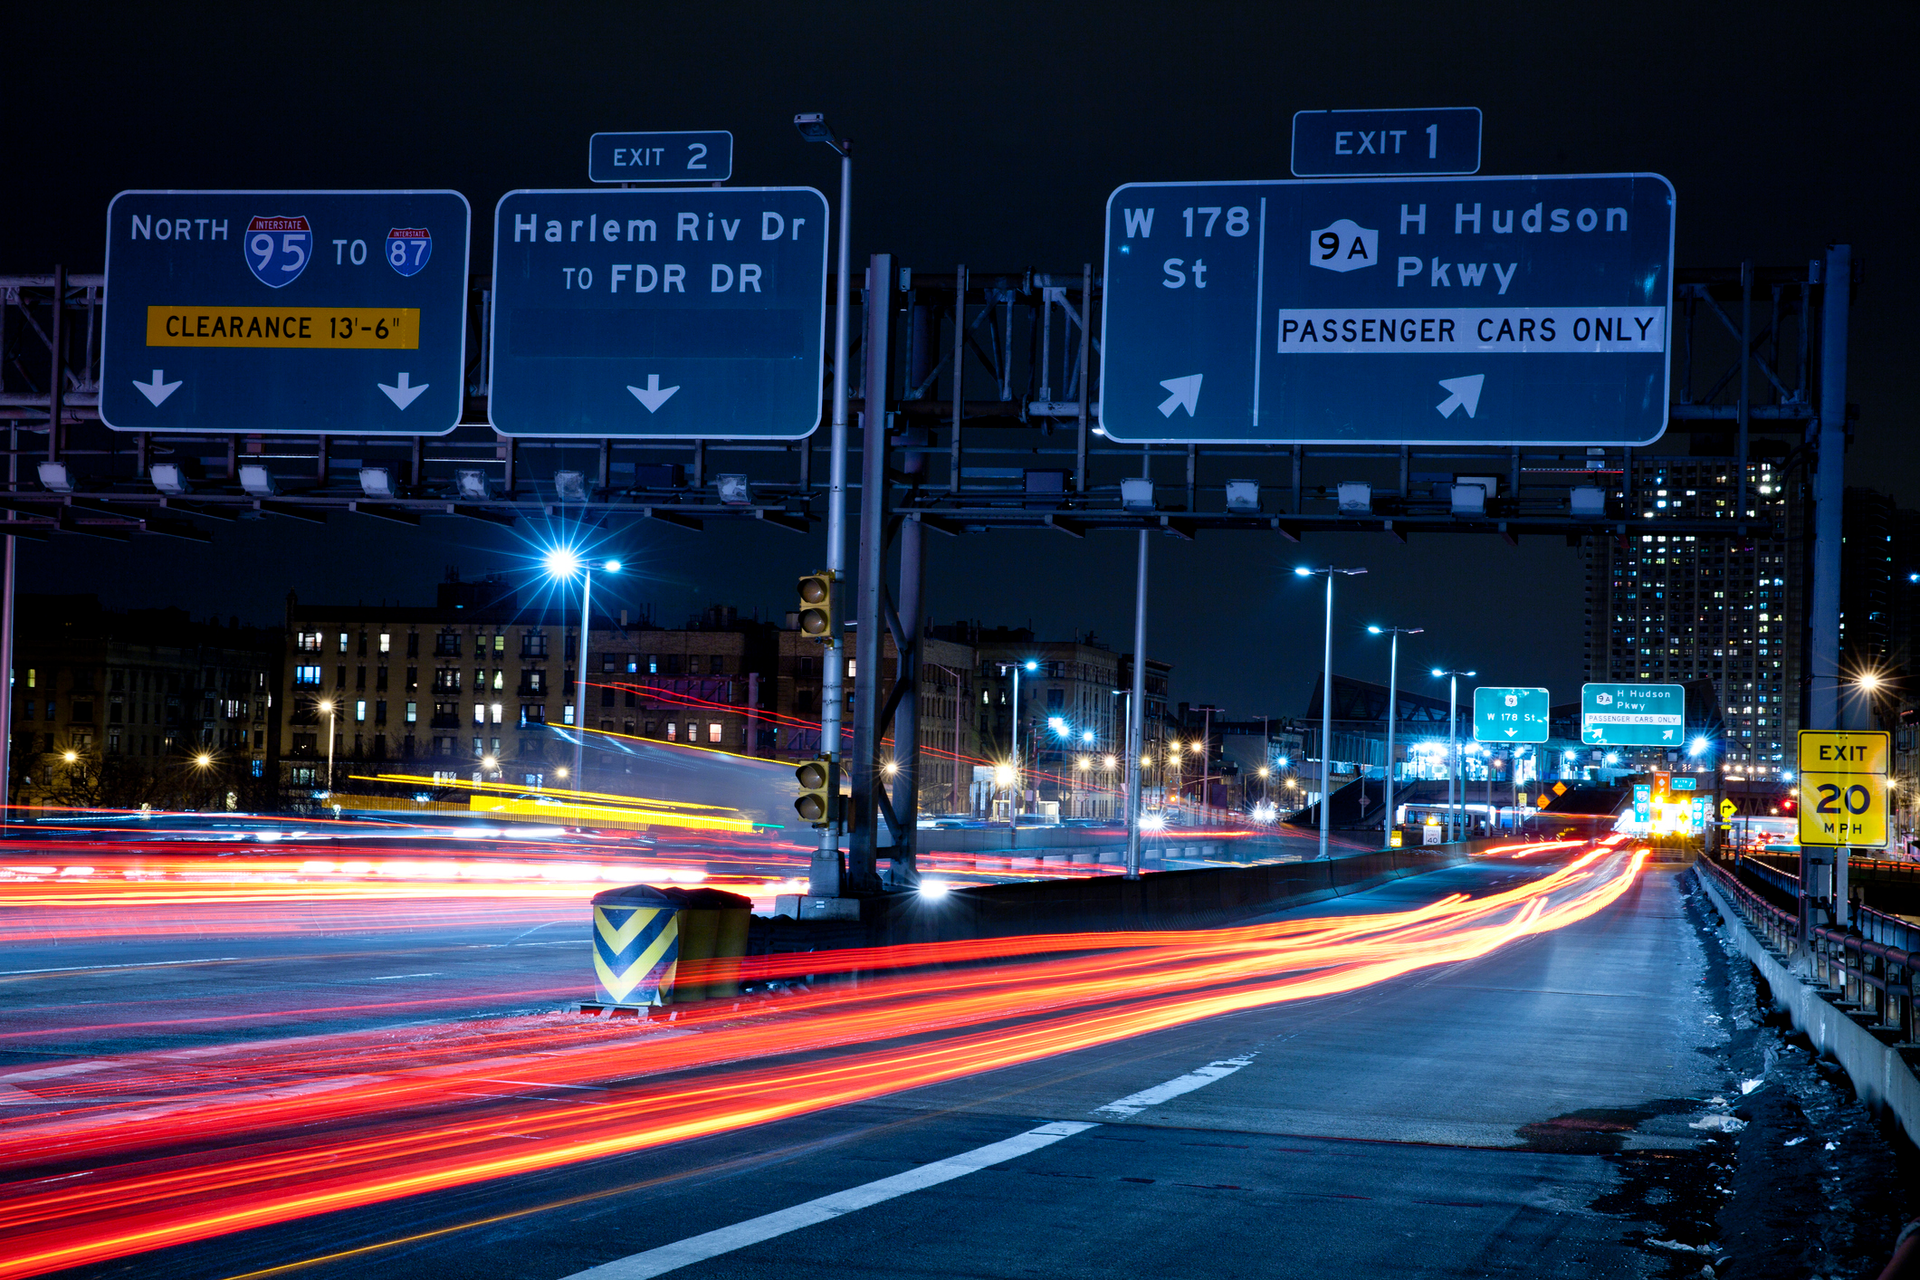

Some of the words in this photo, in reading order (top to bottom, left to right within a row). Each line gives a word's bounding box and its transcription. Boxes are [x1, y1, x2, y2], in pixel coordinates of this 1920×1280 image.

[1335, 130, 1407, 155] EXIT
[1426, 124, 1438, 159] 1
[613, 148, 665, 166] EXIT
[687, 143, 707, 169] 2
[256, 220, 302, 230] INTERSTATE
[514, 213, 657, 242] Harlem
[677, 212, 741, 241] Riv
[761, 211, 806, 241] Dr
[1123, 208, 1155, 238] W
[1183, 206, 1250, 237] 178
[1400, 203, 1426, 235] H
[1455, 202, 1628, 234] Hudson
[131, 214, 228, 240] NORTH
[250, 234, 306, 271] 95
[332, 239, 367, 265] TO
[390, 240, 427, 266] 87
[393, 230, 425, 238] INTERSTATE
[1318, 231, 1369, 260] 9A
[562, 267, 593, 290] TO
[611, 264, 686, 293] FDR
[711, 264, 762, 293] DR
[1162, 257, 1207, 289] St
[1397, 256, 1518, 295] Pkwy
[165, 315, 312, 339] CLEARANCE
[330, 317, 400, 339] 13'-6"
[1282, 318, 1456, 343] PASSENGER
[1477, 318, 1556, 342] CARS
[1573, 316, 1655, 342] ONLY
[1508, 697, 1514, 705] 9
[1617, 701, 1645, 711] Pkwy
[1630, 690, 1671, 698] Hudson
[1487, 713, 1495, 721] W
[1501, 713, 1518, 721] 178
[1524, 713, 1535, 722] St
[1819, 745, 1868, 761] EXIT
[1816, 783, 1871, 815] 20
[1824, 823, 1862, 835] MPH
